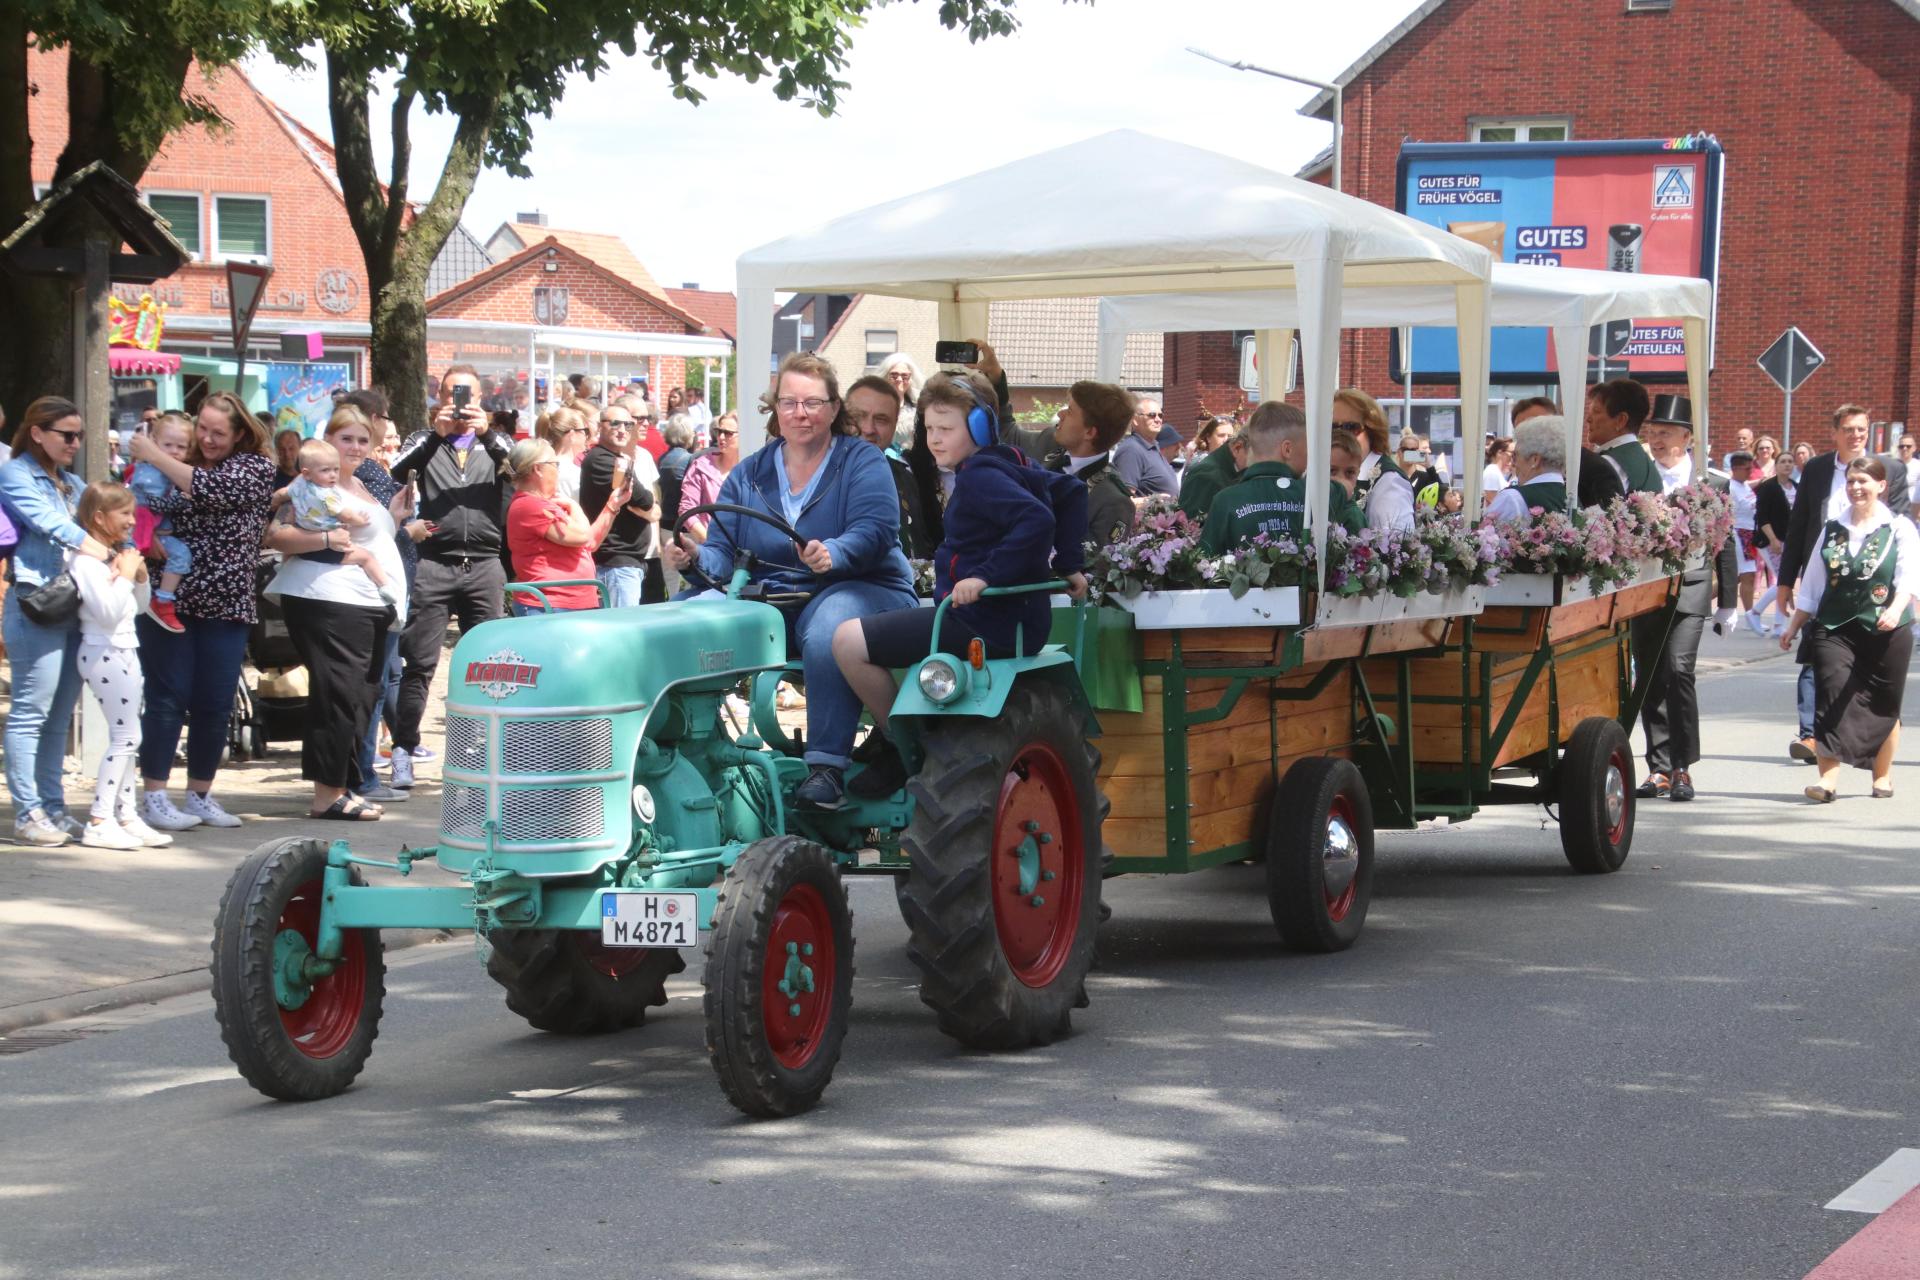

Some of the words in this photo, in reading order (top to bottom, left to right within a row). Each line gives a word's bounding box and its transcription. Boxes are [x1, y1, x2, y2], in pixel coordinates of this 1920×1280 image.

[1662, 134, 1694, 150] awk
[1419, 177, 1455, 188] GUTES
[1457, 174, 1480, 187] FÜR
[1418, 191, 1457, 204] FRÜHE
[1459, 190, 1500, 203] VÖGEL.
[1660, 196, 1688, 204] ALDI
[1518, 228, 1584, 247] GUTES
[1631, 329, 1658, 340] UTES
[1661, 327, 1684, 339] FÜR
[1282, 501, 1305, 512] Bokelo
[607, 907, 613, 915] D
[644, 897, 657, 918] H
